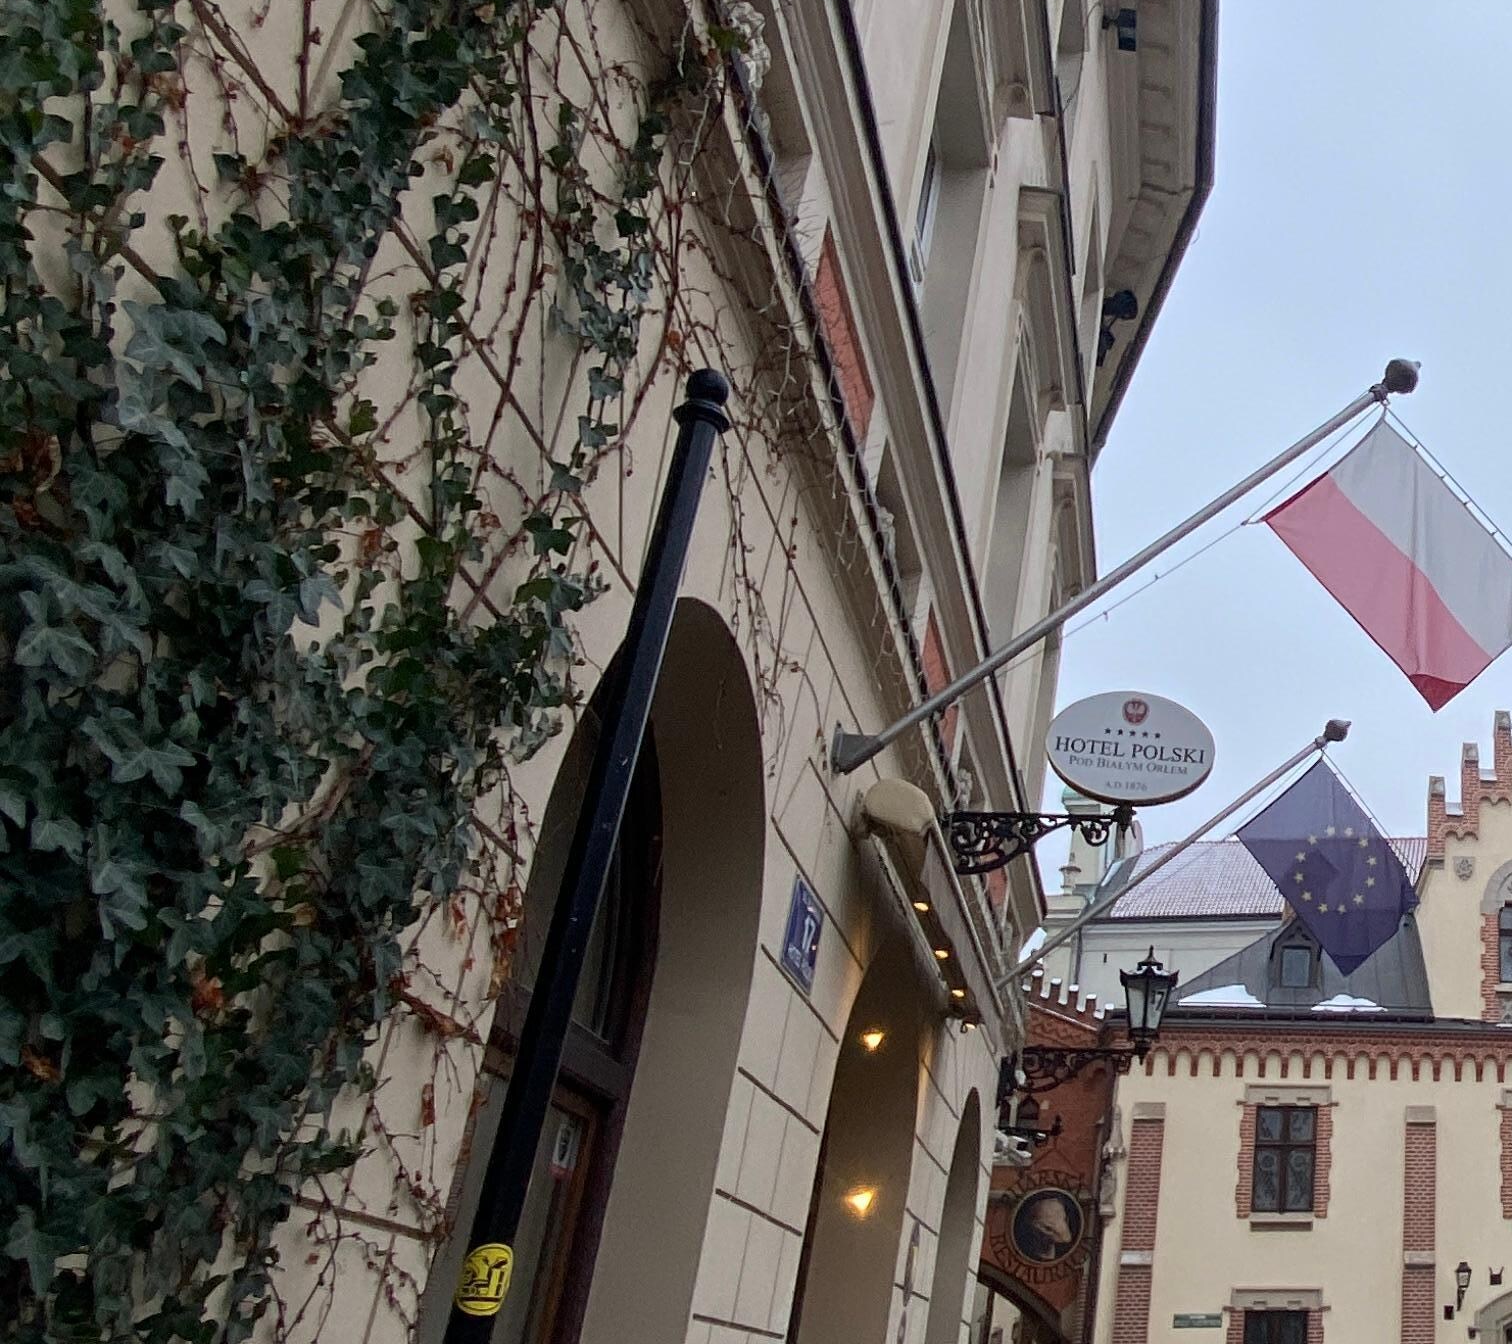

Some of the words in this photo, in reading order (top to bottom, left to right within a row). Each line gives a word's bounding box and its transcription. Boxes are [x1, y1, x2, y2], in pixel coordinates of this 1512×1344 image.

[1054, 736, 1125, 757] HOTEL
[1131, 743, 1205, 764] POLSKI
[1068, 755, 1093, 766] POD
[1151, 989, 1164, 1011] 17
